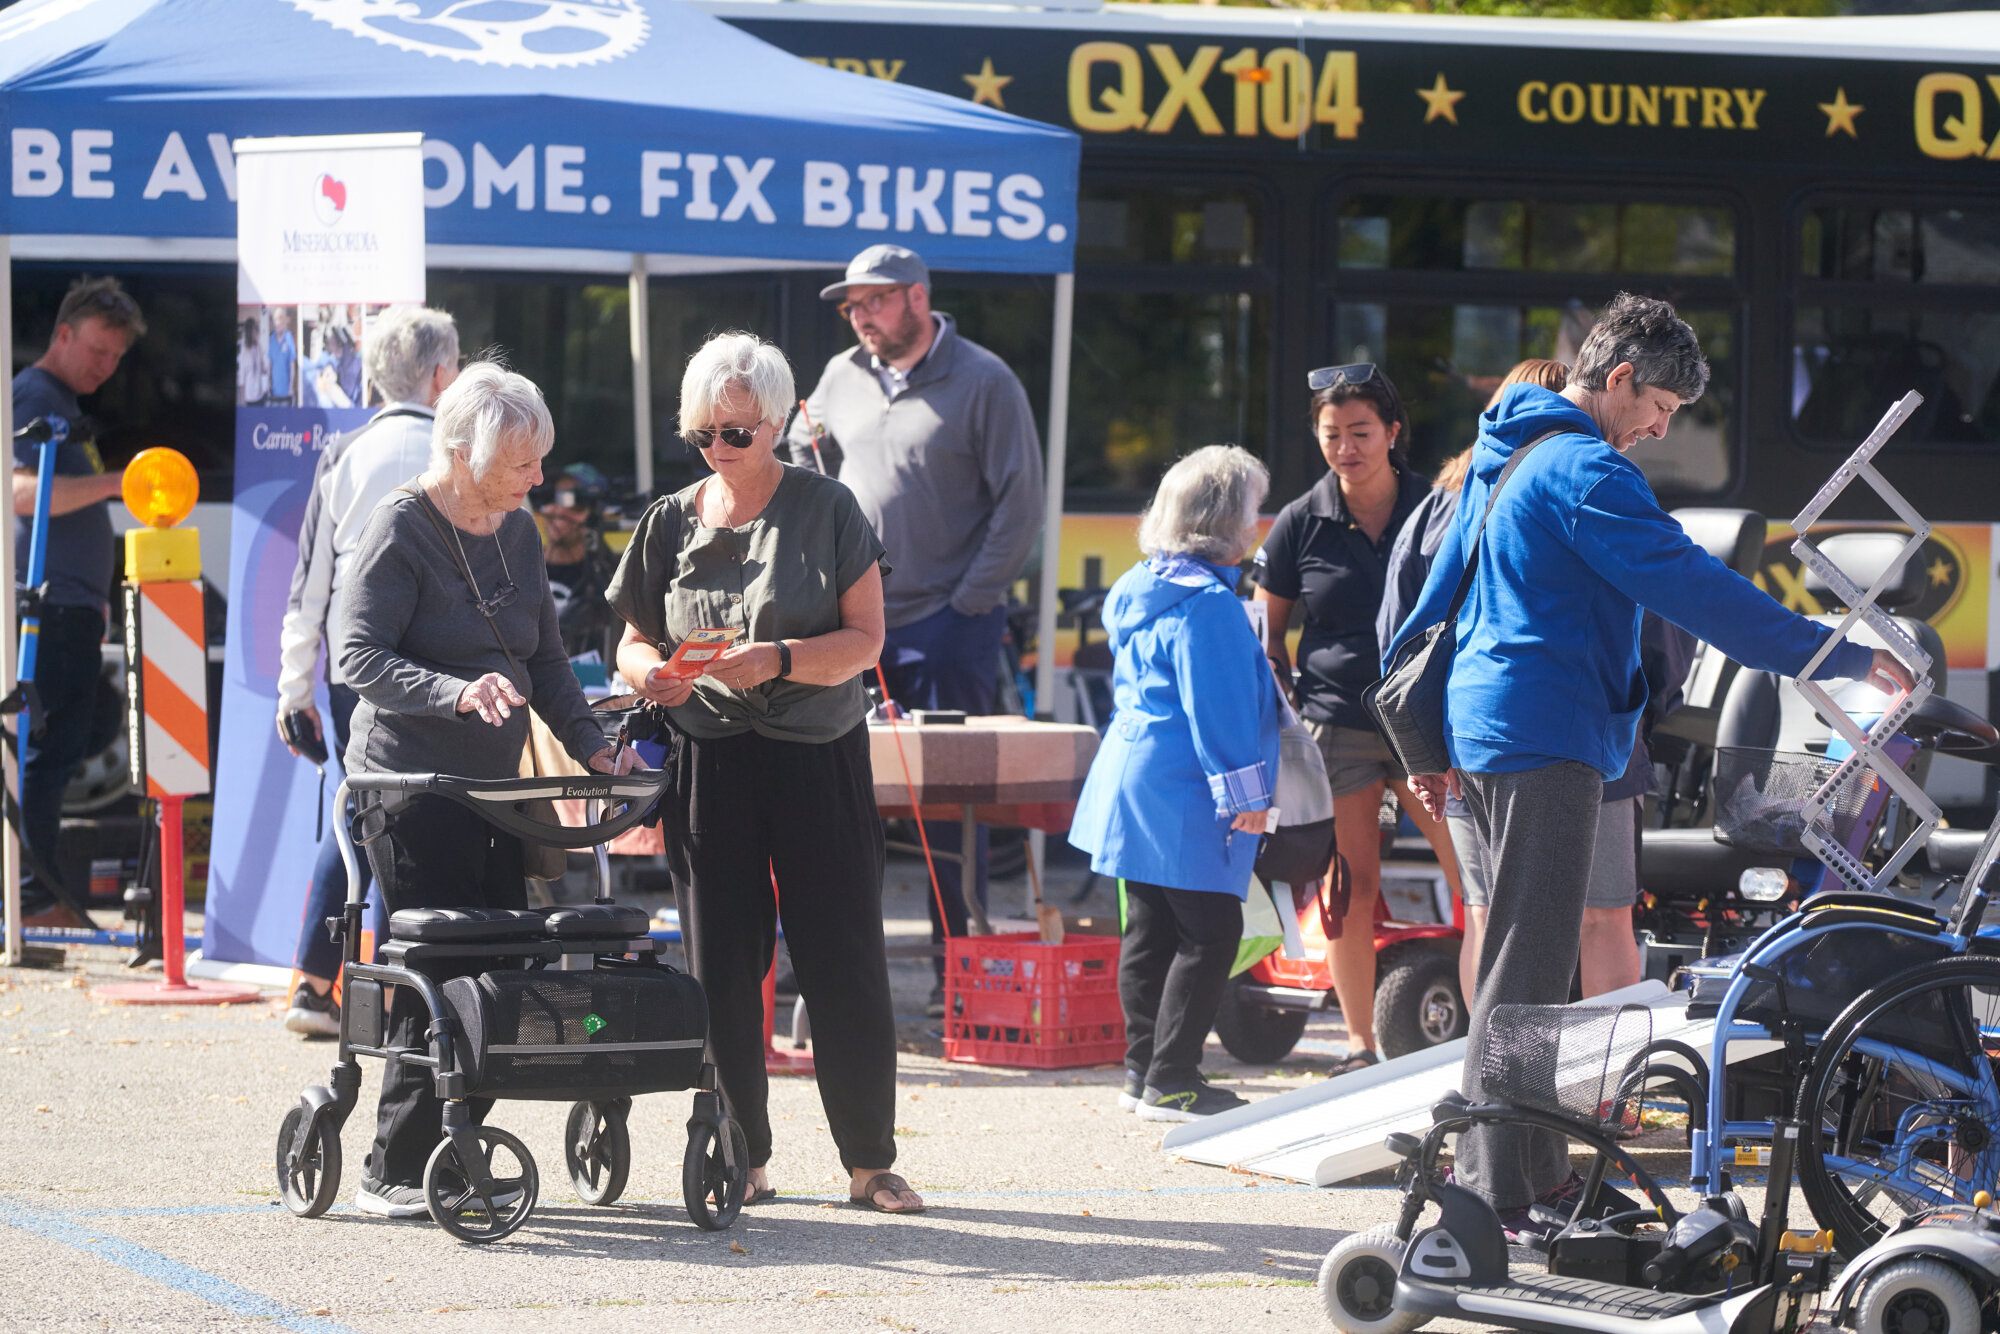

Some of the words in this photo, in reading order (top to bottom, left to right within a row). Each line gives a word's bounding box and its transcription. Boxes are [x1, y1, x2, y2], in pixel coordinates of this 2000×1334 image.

[1067, 40, 1364, 140] QX104
[1517, 80, 1767, 130] COUNTRY
[11, 128, 115, 199] BE
[641, 150, 776, 224] FIX
[803, 160, 1067, 243] BIKES.
[252, 422, 303, 457] Caring
[566, 786, 608, 797] Evolution
